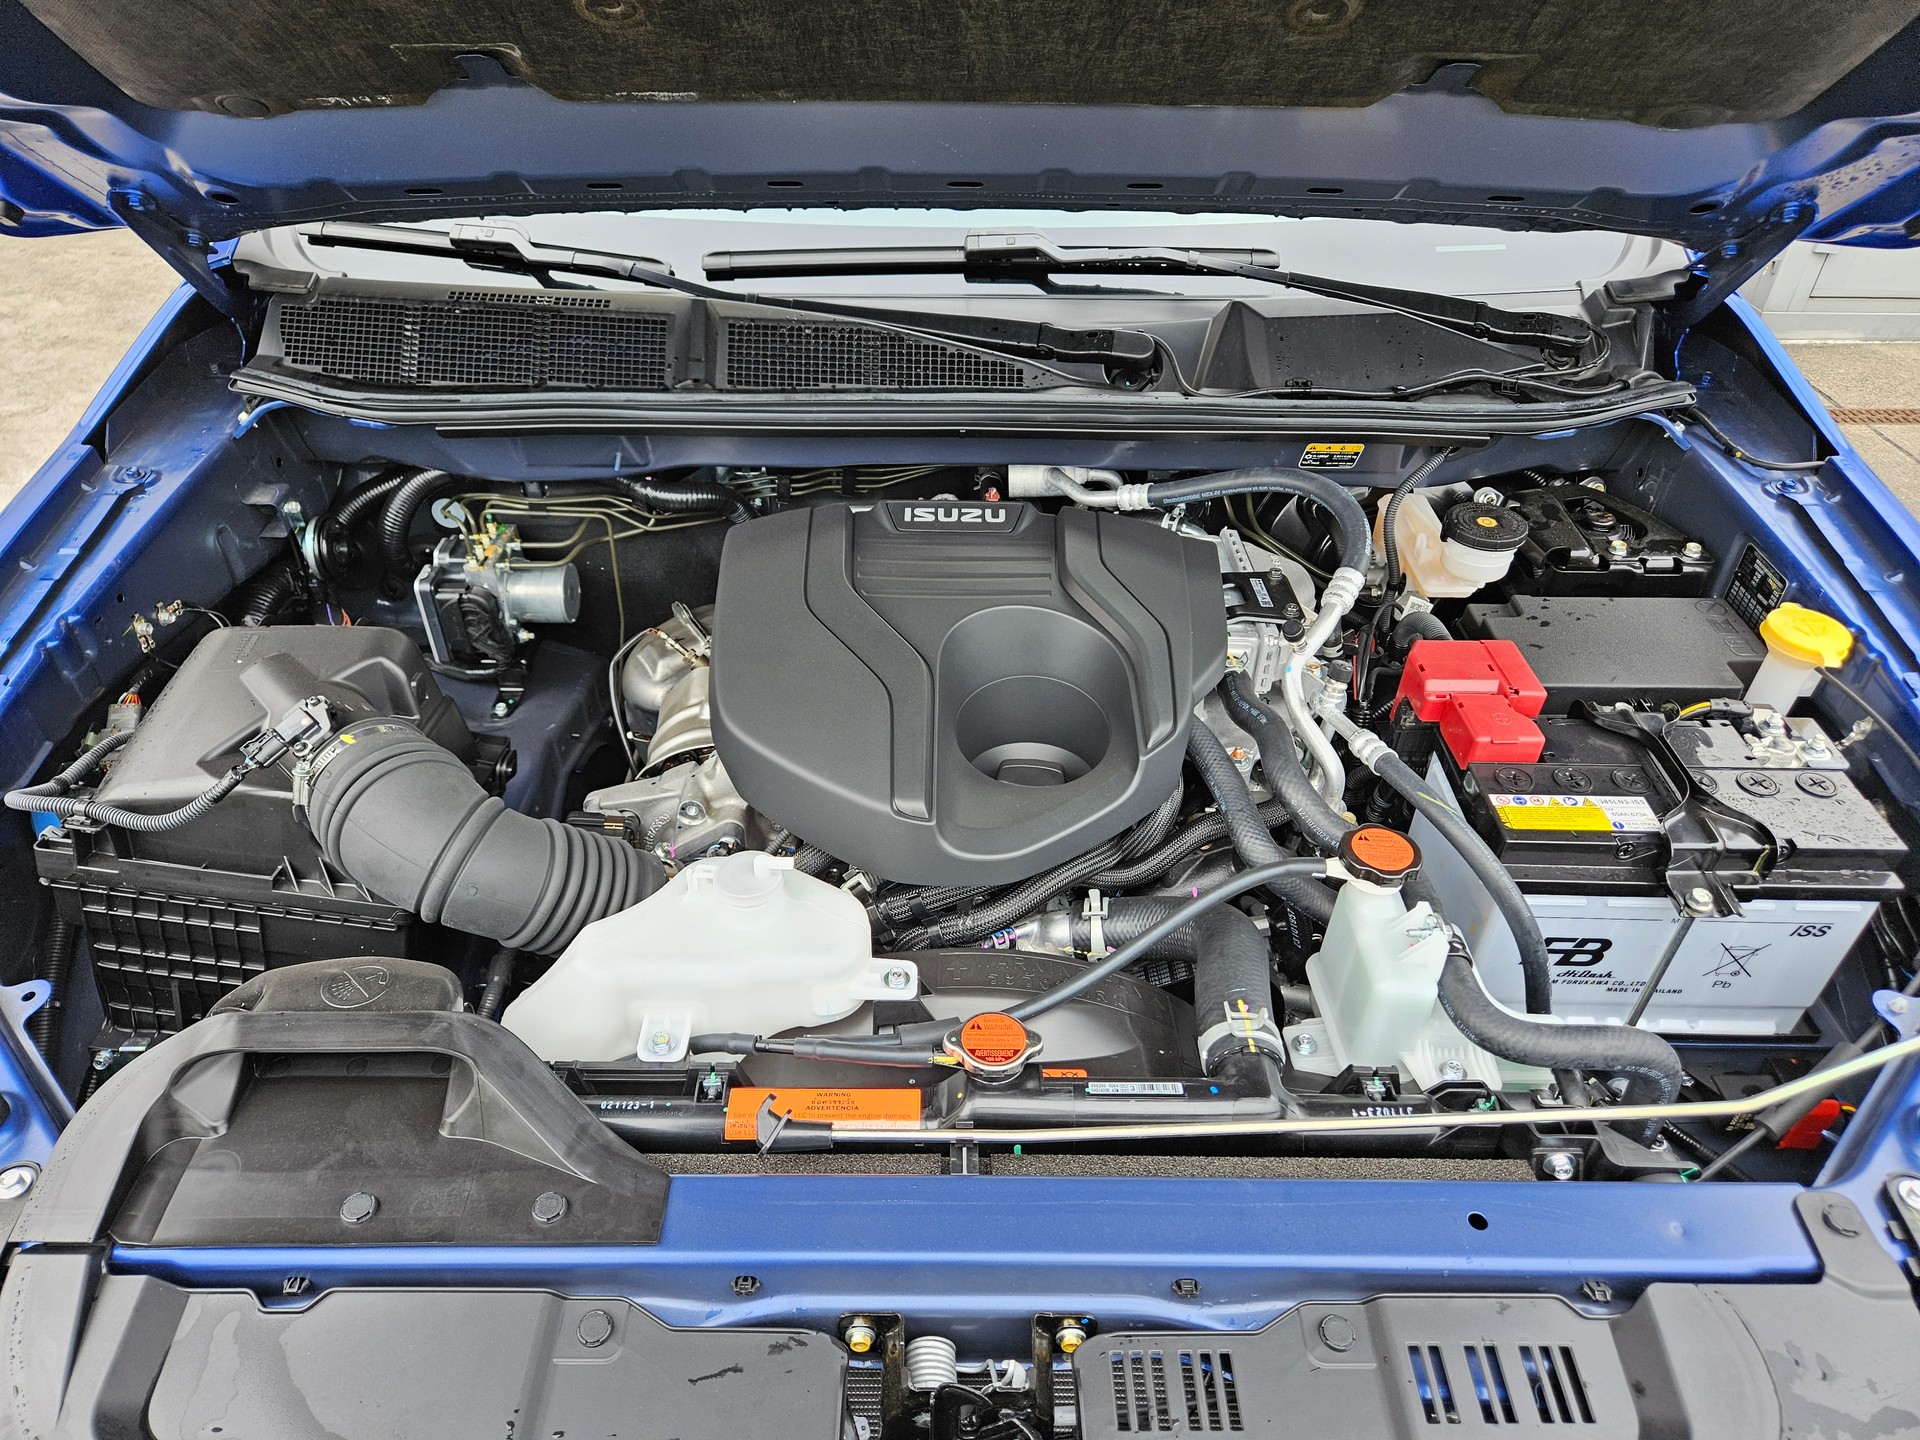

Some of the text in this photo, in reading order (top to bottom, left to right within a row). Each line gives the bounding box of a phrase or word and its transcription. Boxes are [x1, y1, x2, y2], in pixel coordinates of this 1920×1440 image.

[904, 507, 1006, 523] ISUZU
[1789, 925, 1832, 937] ISS
[1711, 981, 1732, 989] Pb
[600, 1101, 655, 1110] 021123-1
